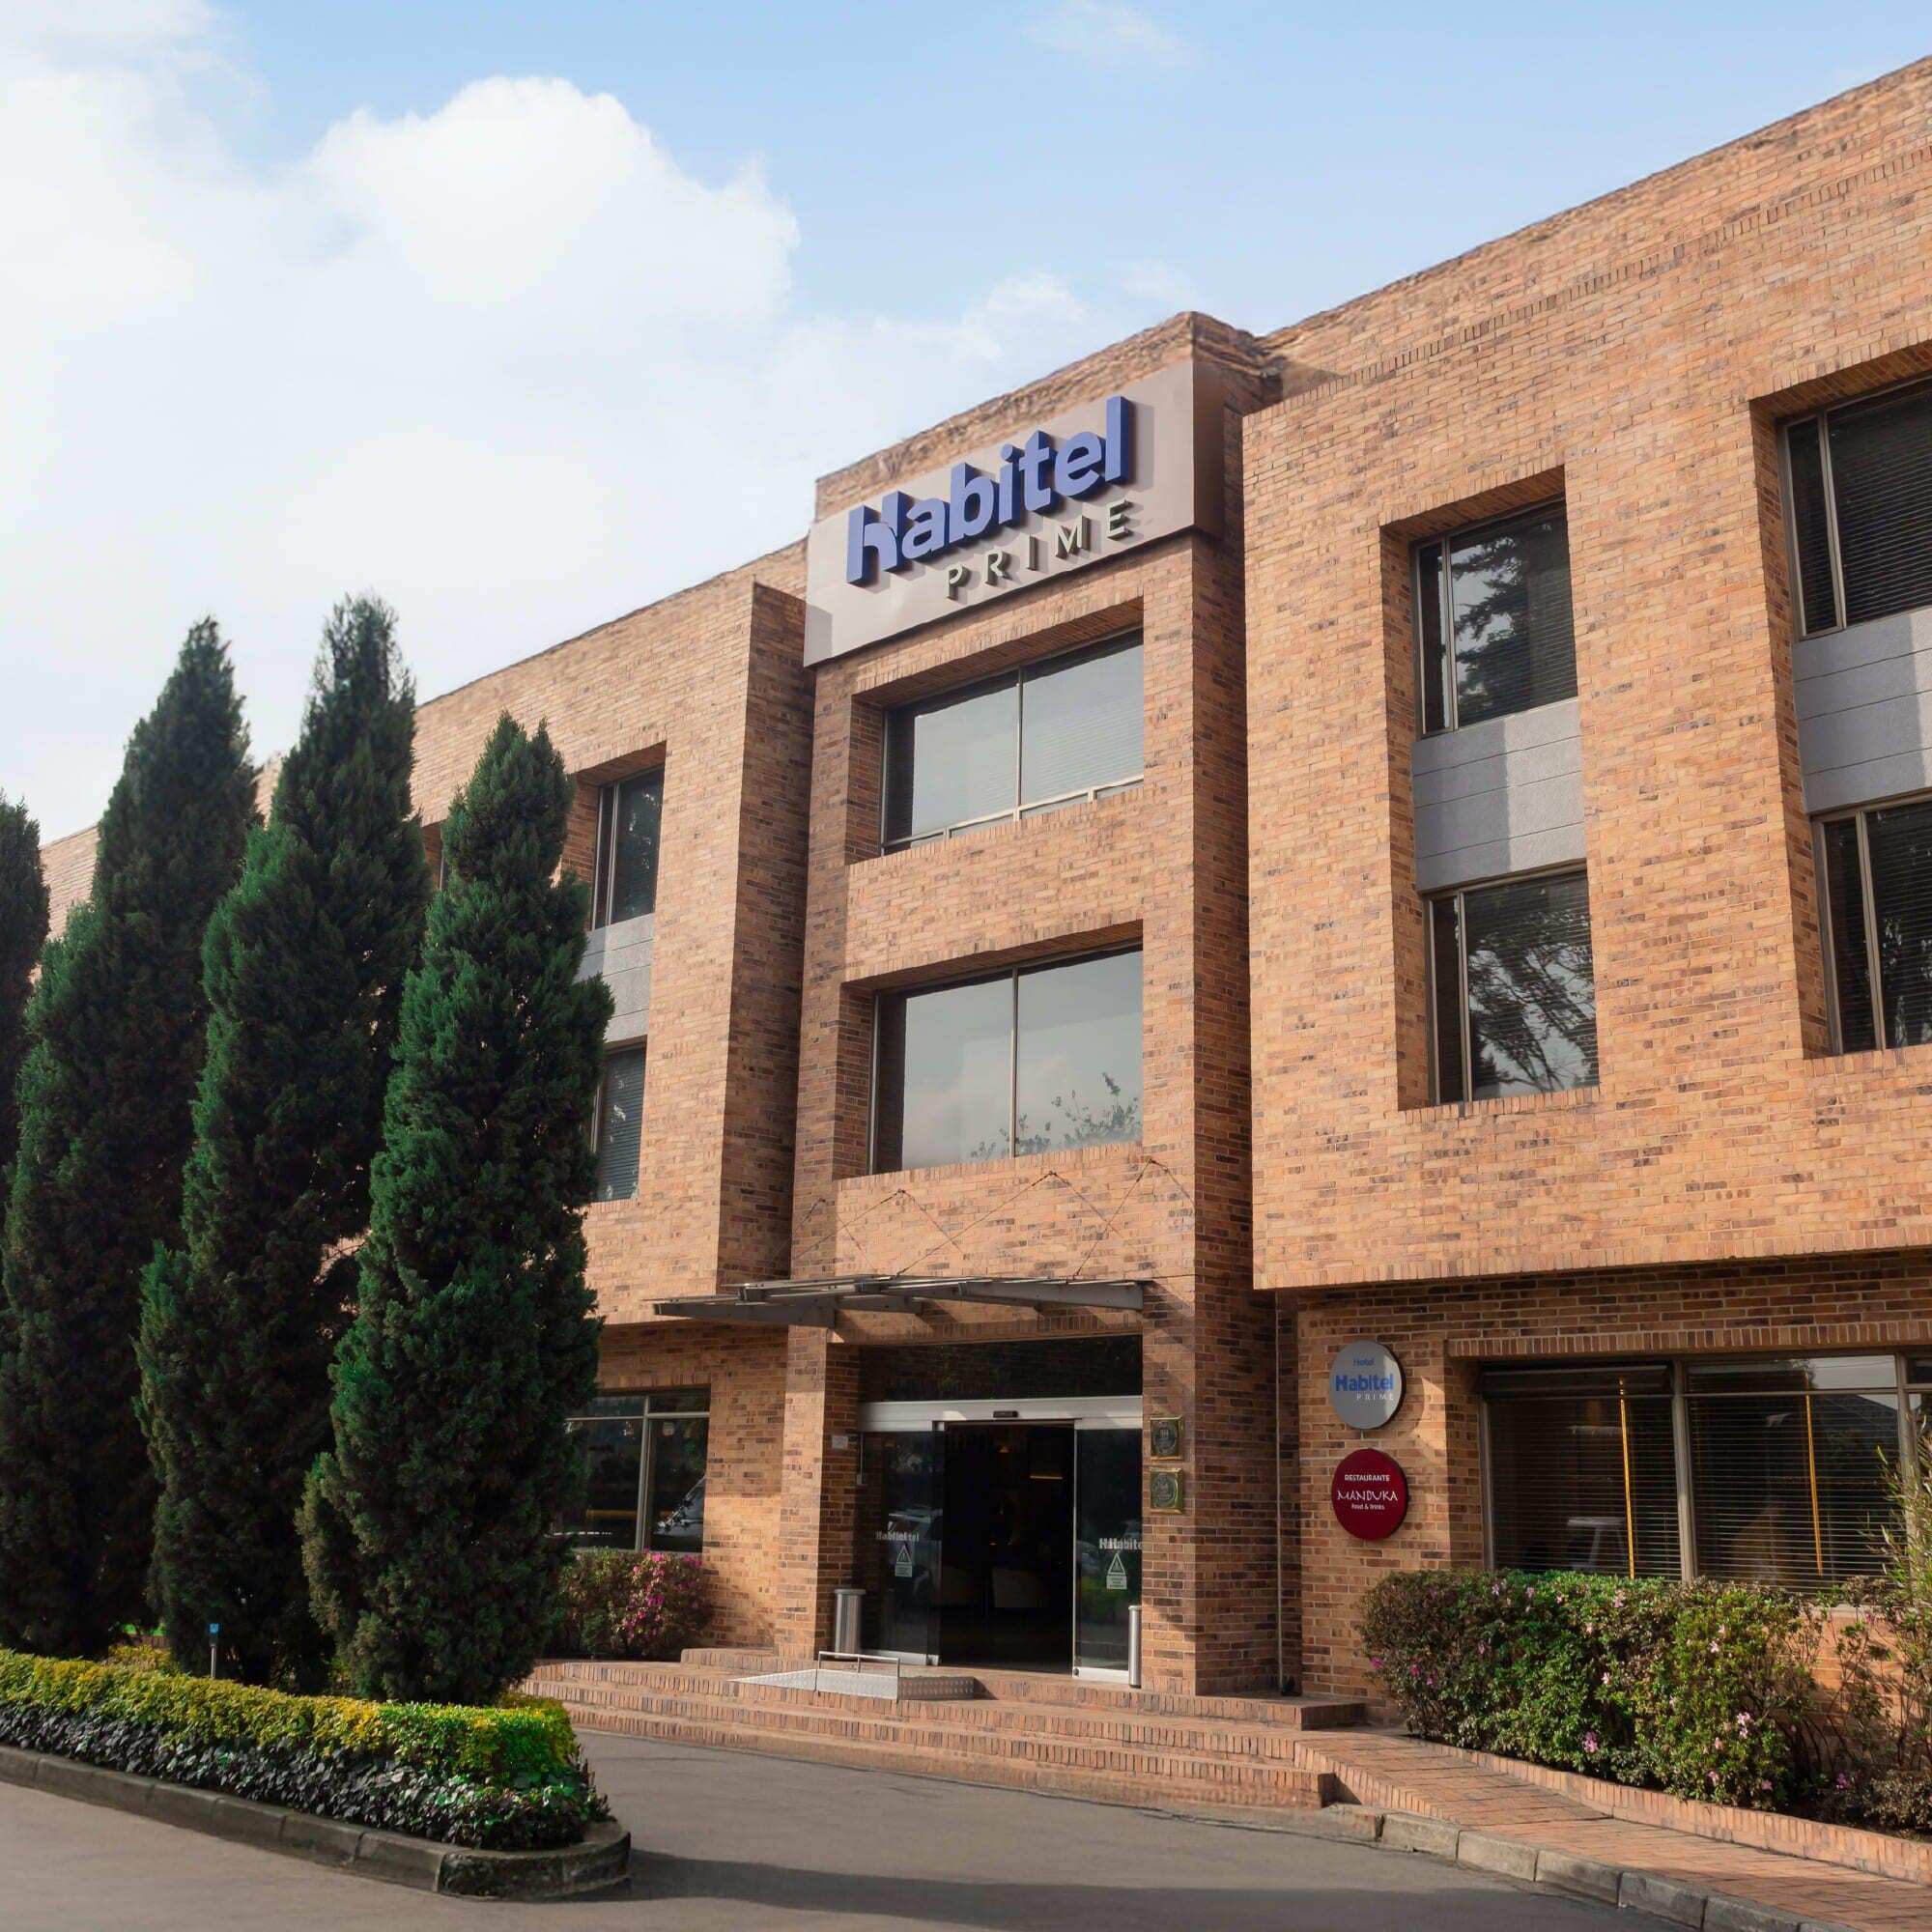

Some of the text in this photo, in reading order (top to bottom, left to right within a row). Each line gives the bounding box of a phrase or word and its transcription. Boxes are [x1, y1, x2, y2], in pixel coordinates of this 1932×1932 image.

[946, 499, 1133, 601] PRIME
[1335, 1374, 1394, 1392] Habitel
[1337, 1490, 1398, 1501] MANDUKA
